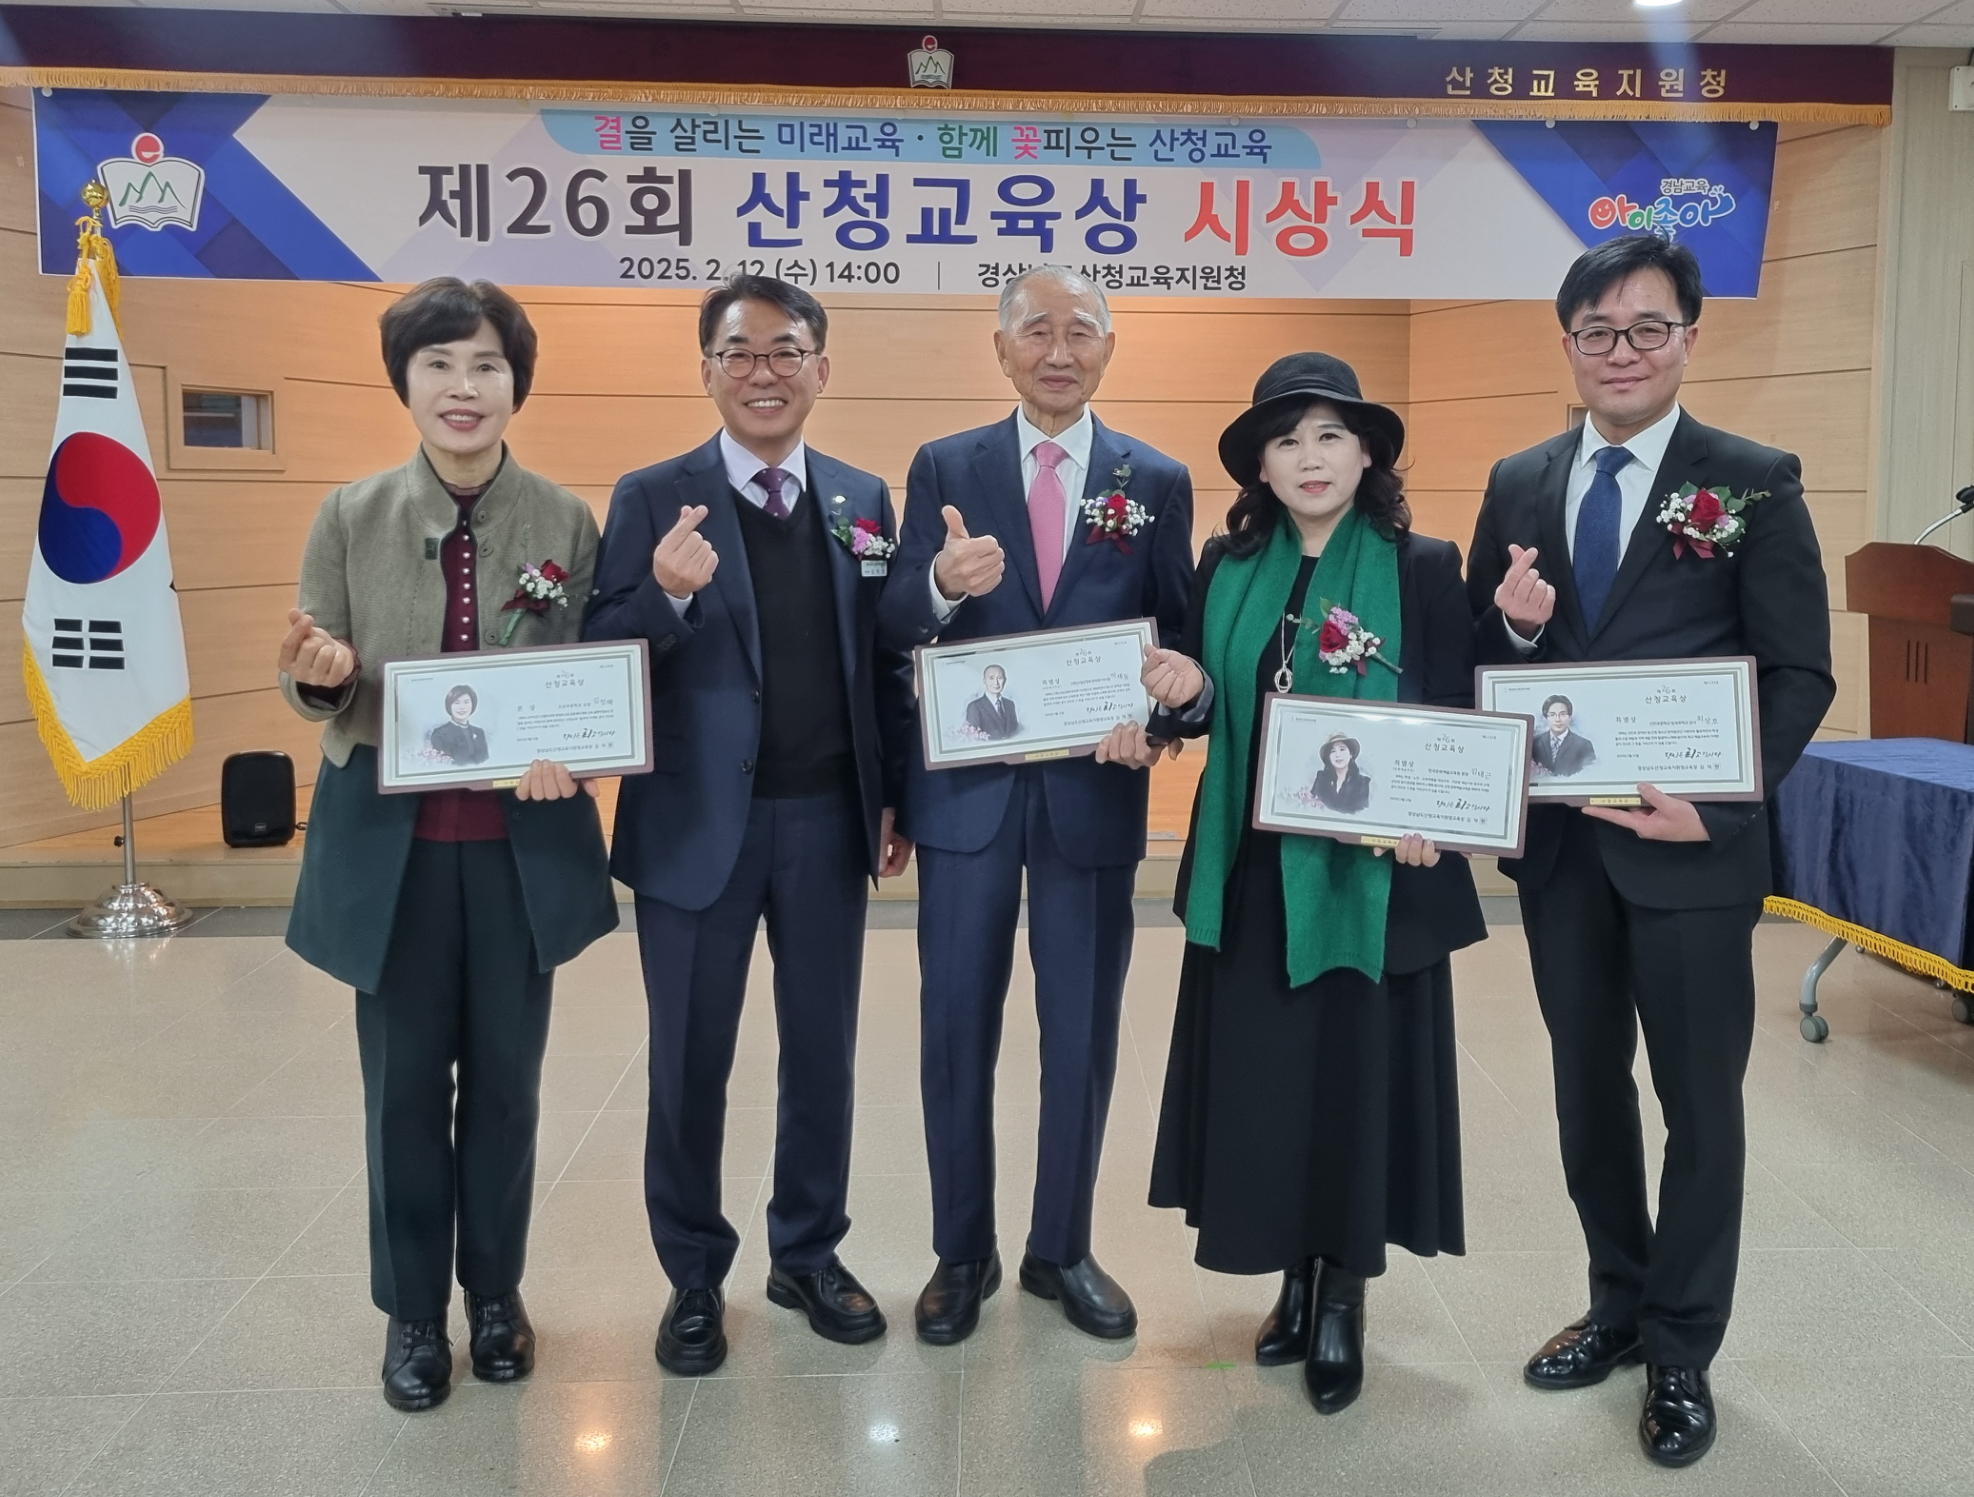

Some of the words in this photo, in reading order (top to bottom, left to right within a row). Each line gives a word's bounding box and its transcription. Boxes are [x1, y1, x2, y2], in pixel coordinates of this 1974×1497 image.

[1445, 66, 1728, 99] 산청교육지원청
[593, 114, 657, 152] 결을
[670, 118, 765, 154] 살리는
[776, 120, 903, 157] 미래교육
[937, 124, 998, 158] 함께
[1011, 125, 1137, 160] 꽃피우는
[1148, 127, 1273, 164] 산청교육
[1661, 180, 1708, 195] 경남교육
[418, 162, 692, 247] 제26회
[736, 168, 1148, 256] 산청교육상
[1184, 177, 1416, 257] 시상식
[619, 257, 698, 281] 2025.
[775, 257, 818, 286] (수)
[825, 261, 901, 284] 14:00
[977, 262, 1247, 291] 경상산청교육지원청
